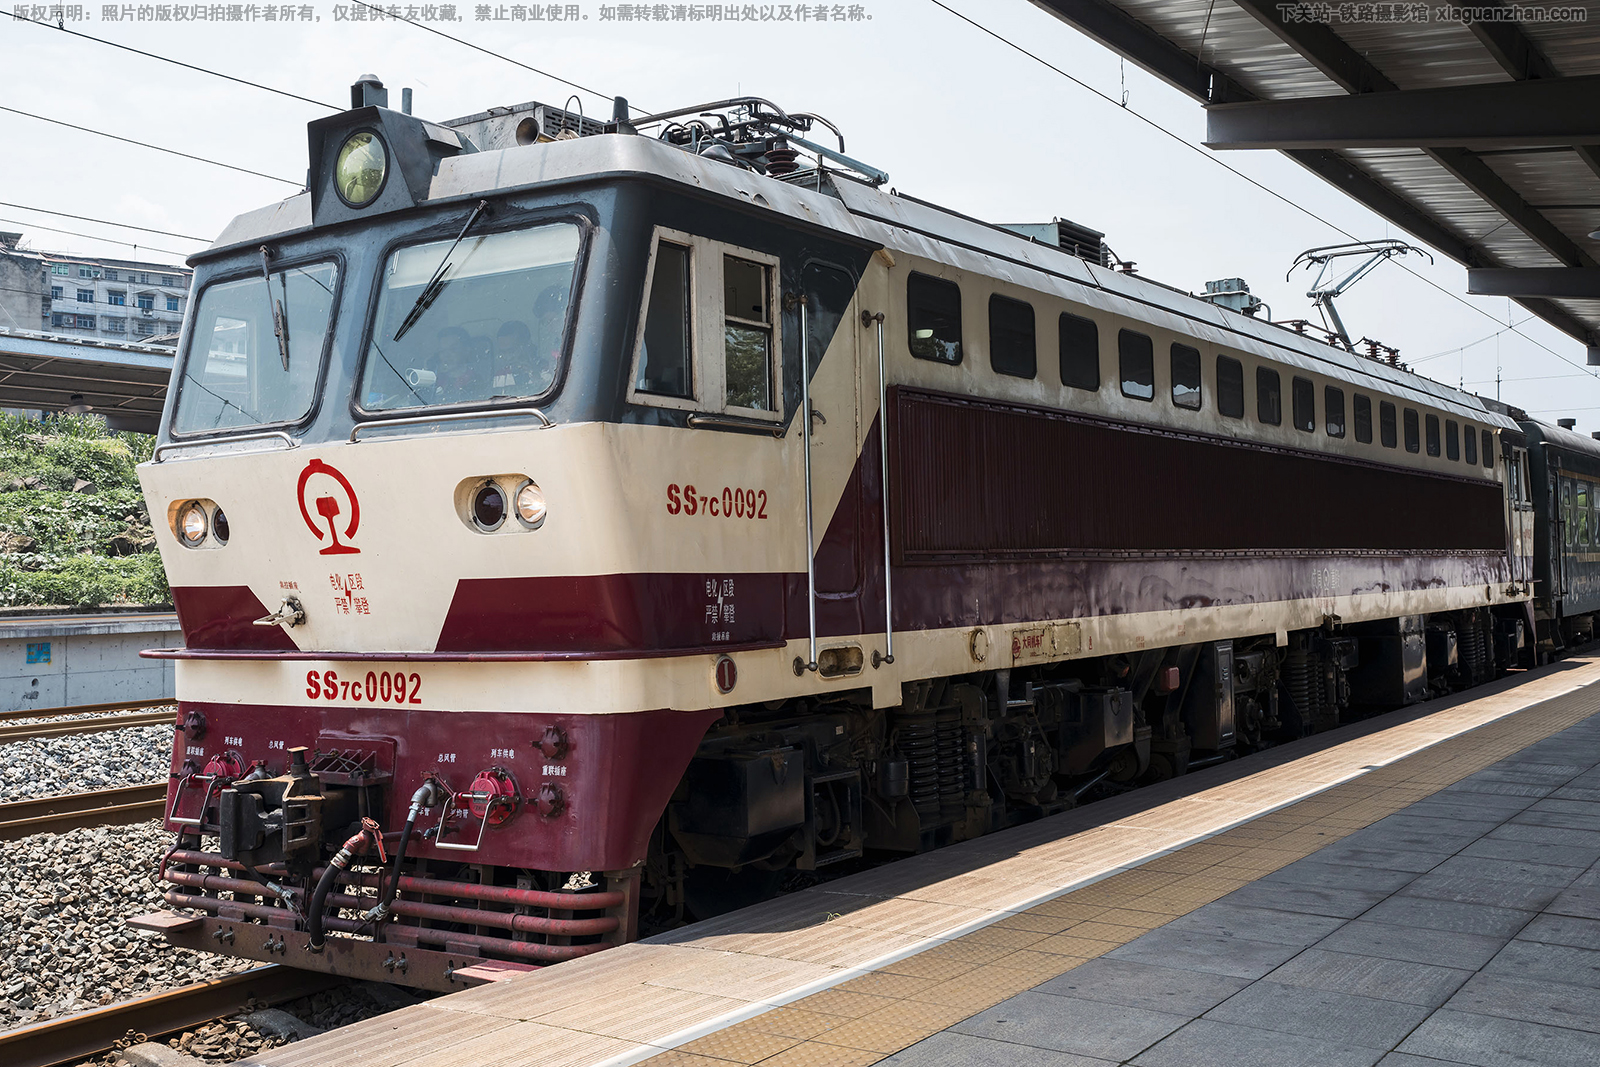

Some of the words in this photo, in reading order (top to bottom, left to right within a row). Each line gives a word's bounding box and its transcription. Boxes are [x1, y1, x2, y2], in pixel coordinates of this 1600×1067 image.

[437, 753, 457, 763] 总风管
[490, 748, 515, 760] 列车供电
[541, 764, 568, 777] 重联插座
